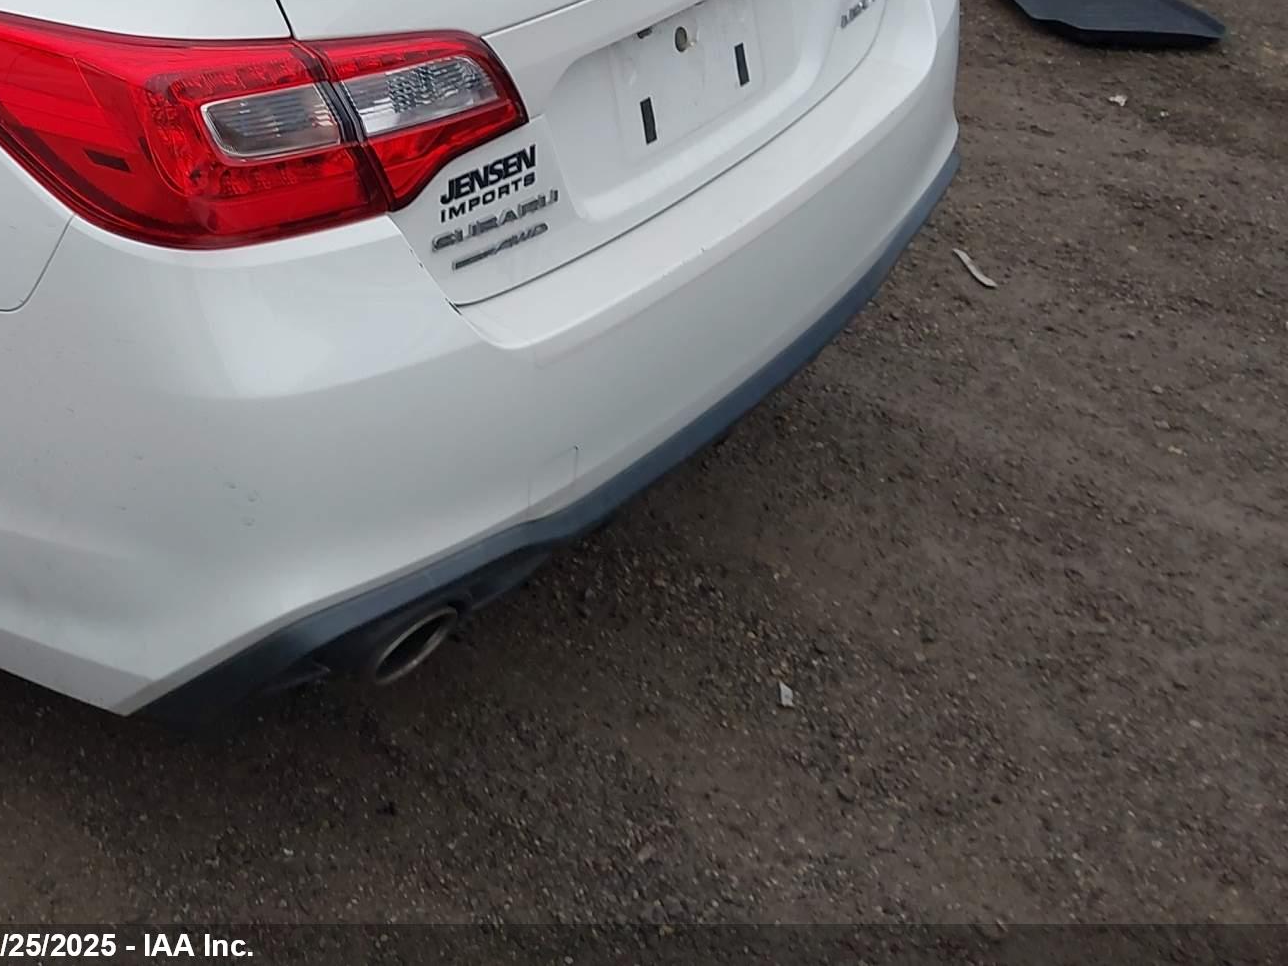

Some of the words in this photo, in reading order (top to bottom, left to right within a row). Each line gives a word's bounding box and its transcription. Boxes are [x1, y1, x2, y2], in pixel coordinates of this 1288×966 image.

[440, 143, 536, 205] JENSEN
[440, 172, 536, 223] IMPORTS
[432, 189, 559, 252] SUBARU
